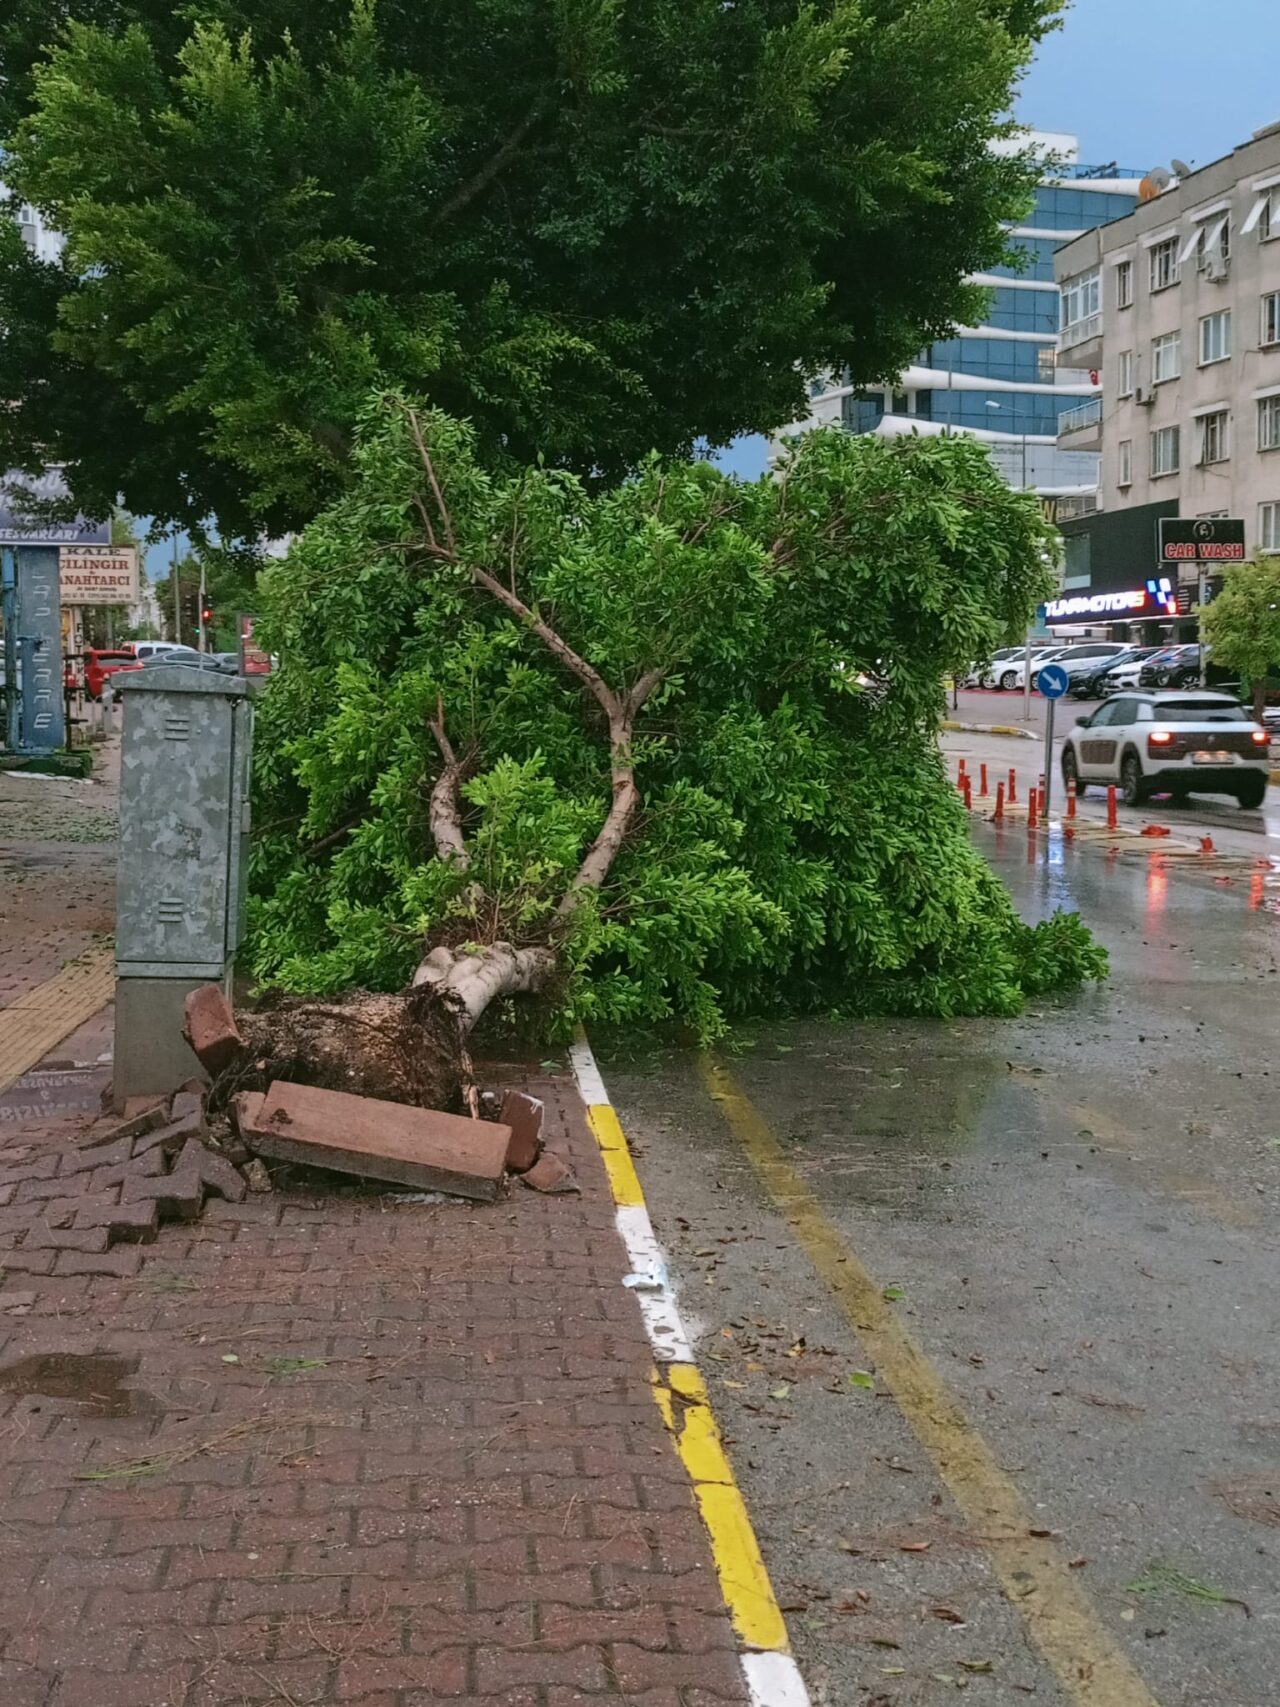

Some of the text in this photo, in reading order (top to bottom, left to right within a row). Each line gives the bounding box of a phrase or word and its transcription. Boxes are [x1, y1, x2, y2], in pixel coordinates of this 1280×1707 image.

[66, 548, 121, 556] KALE
[1165, 543, 1243, 559] CAR WASH
